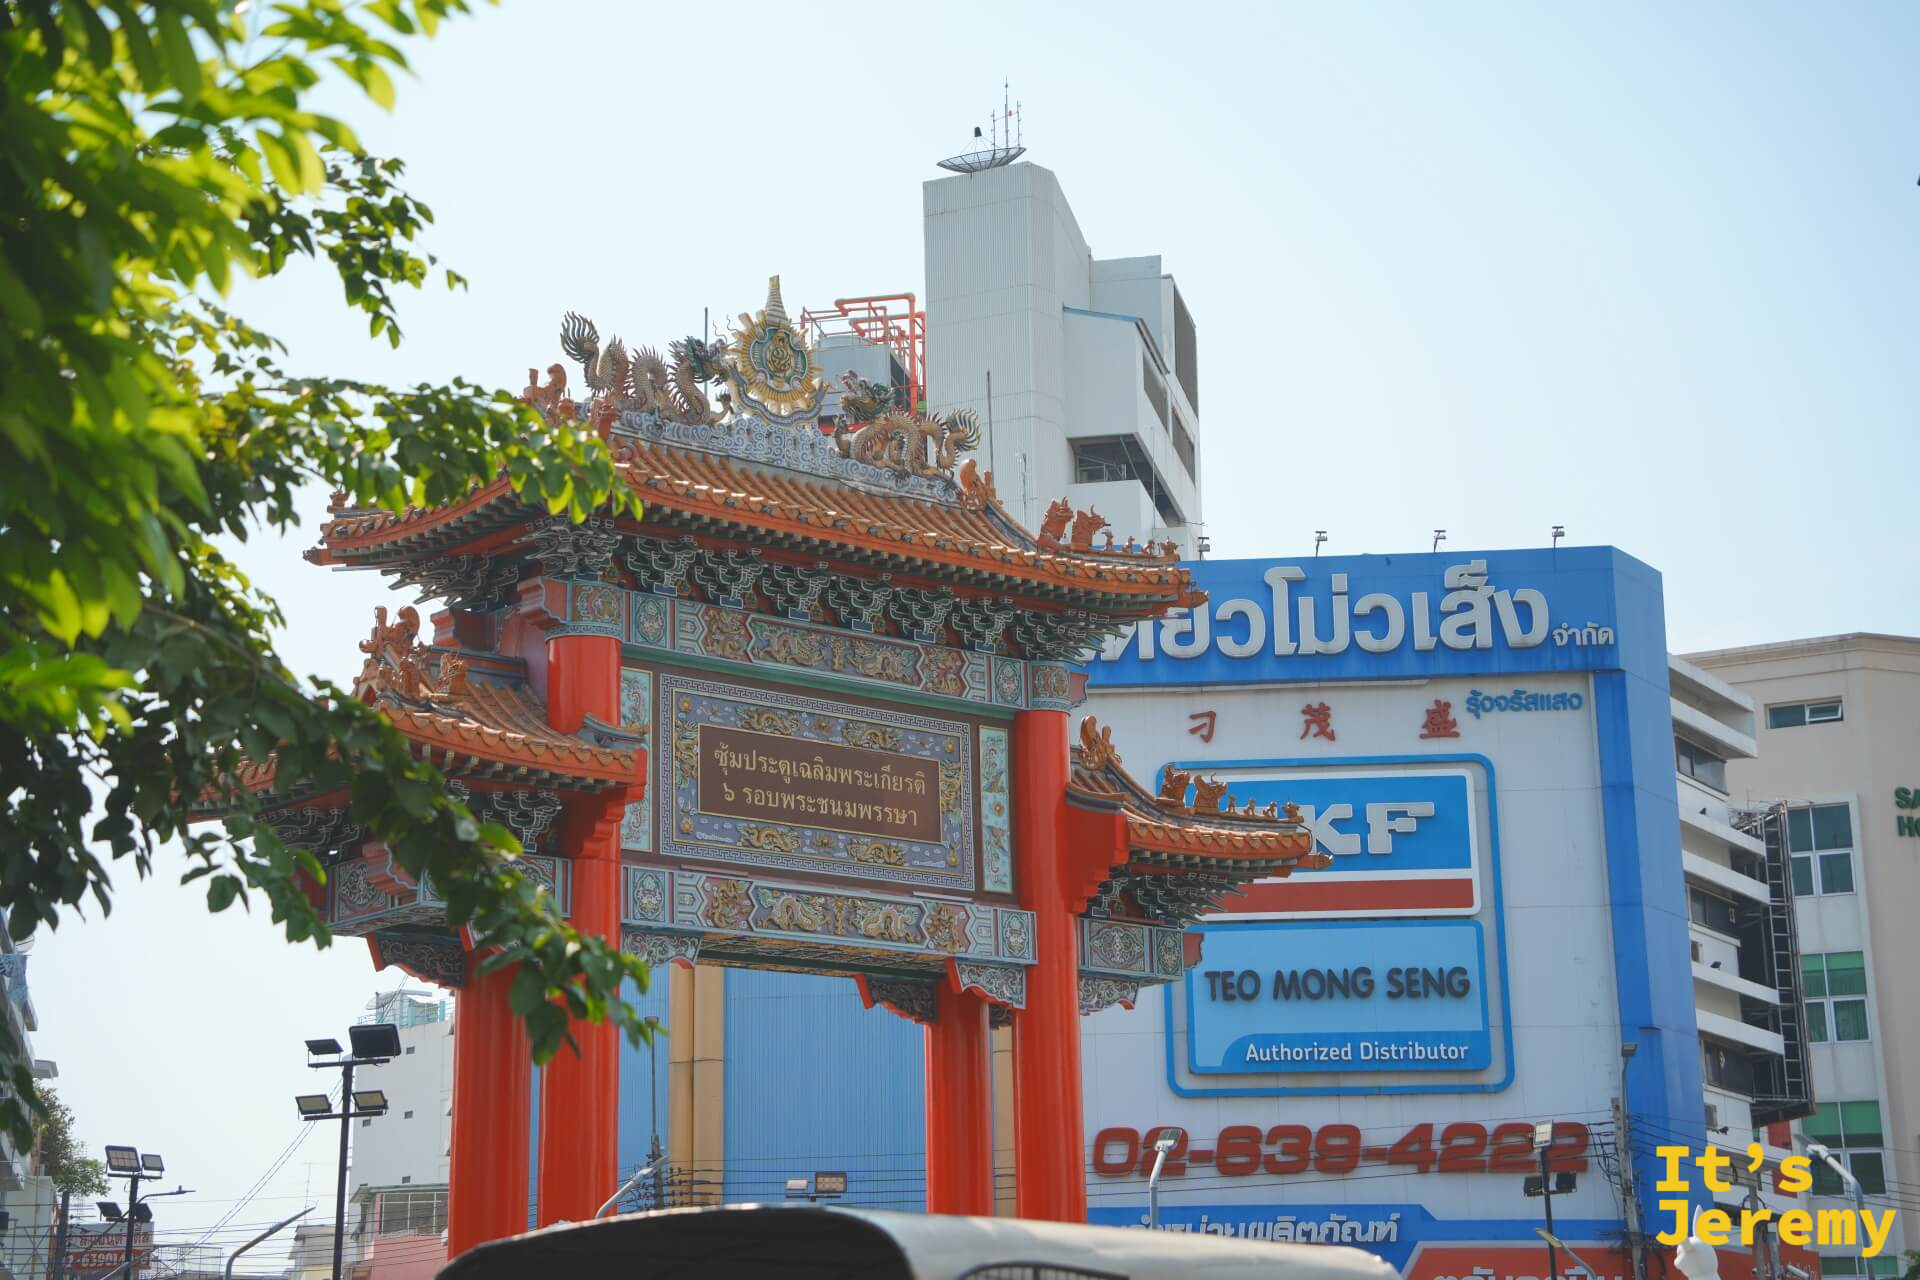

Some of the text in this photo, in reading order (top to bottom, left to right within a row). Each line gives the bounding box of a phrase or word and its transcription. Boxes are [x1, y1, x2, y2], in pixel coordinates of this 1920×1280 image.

[1552, 621, 1614, 646] จำกัด
[1466, 689, 1584, 720] รุ้งจรัสแสง
[714, 743, 926, 795] ซุ้มประตูเฉลิมพระเกียรติ
[742, 786, 918, 827] รอบพระชนมพรรษา
[1204, 965, 1471, 1001] TEO MONG SENG
[1245, 1040, 1469, 1062] Authorized Distributor
[1093, 1121, 1590, 1177] 02-639-4222
